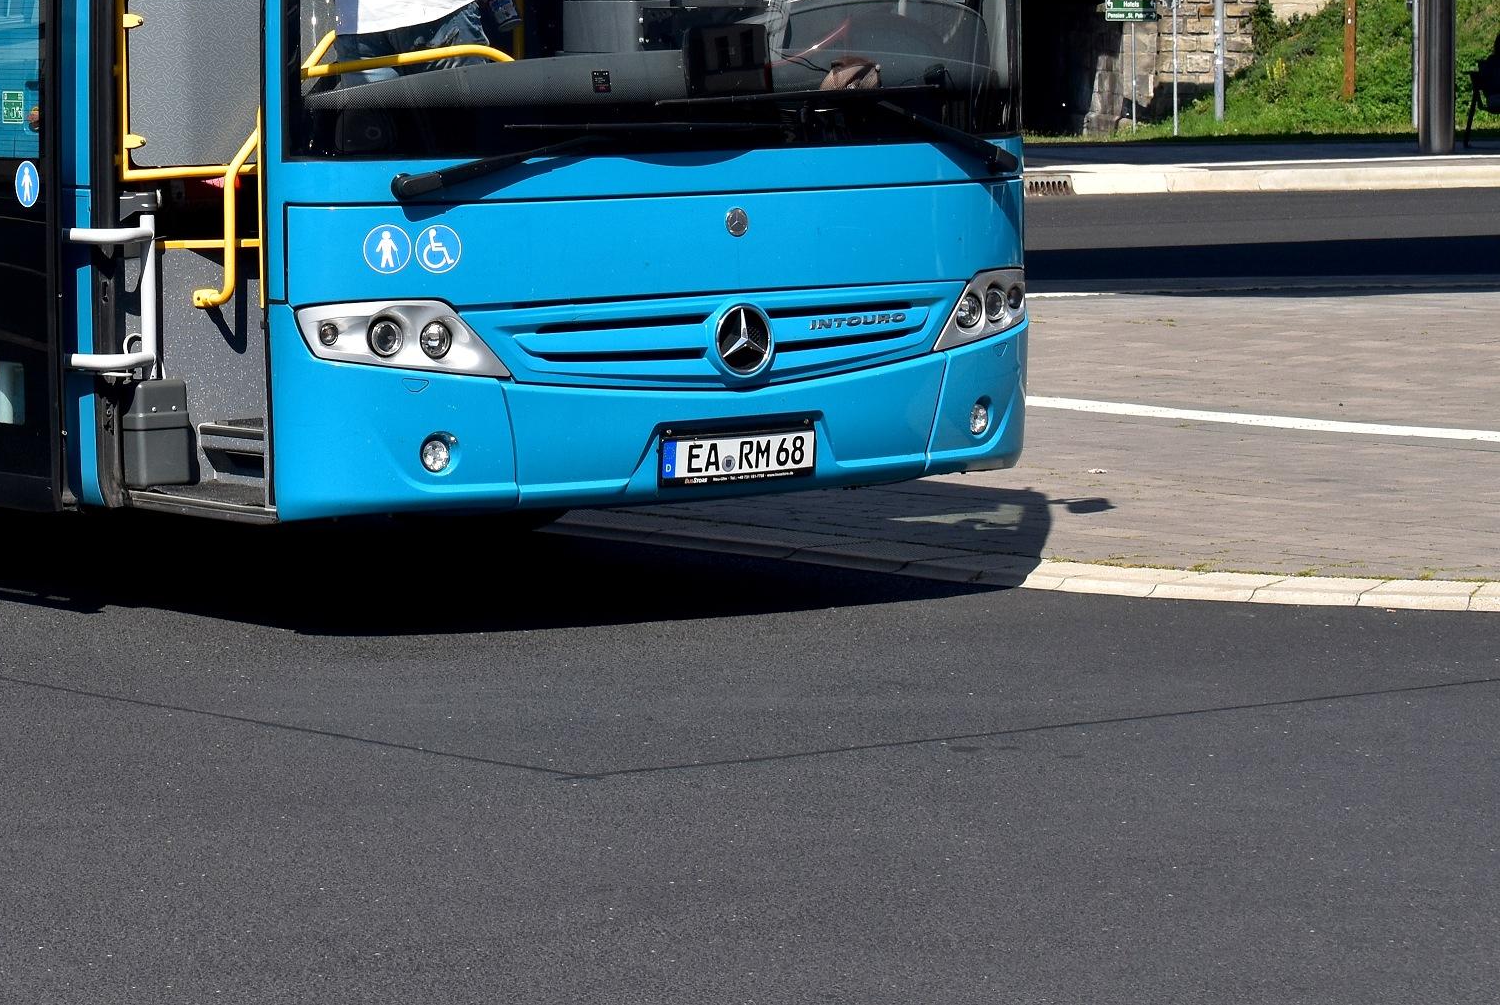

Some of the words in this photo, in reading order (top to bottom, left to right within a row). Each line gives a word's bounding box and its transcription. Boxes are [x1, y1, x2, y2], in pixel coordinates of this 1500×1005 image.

[809, 312, 907, 330] INTOURO
[687, 443, 720, 473] EA
[738, 439, 771, 470] RM
[775, 435, 805, 467] 68
[665, 464, 671, 472] D
